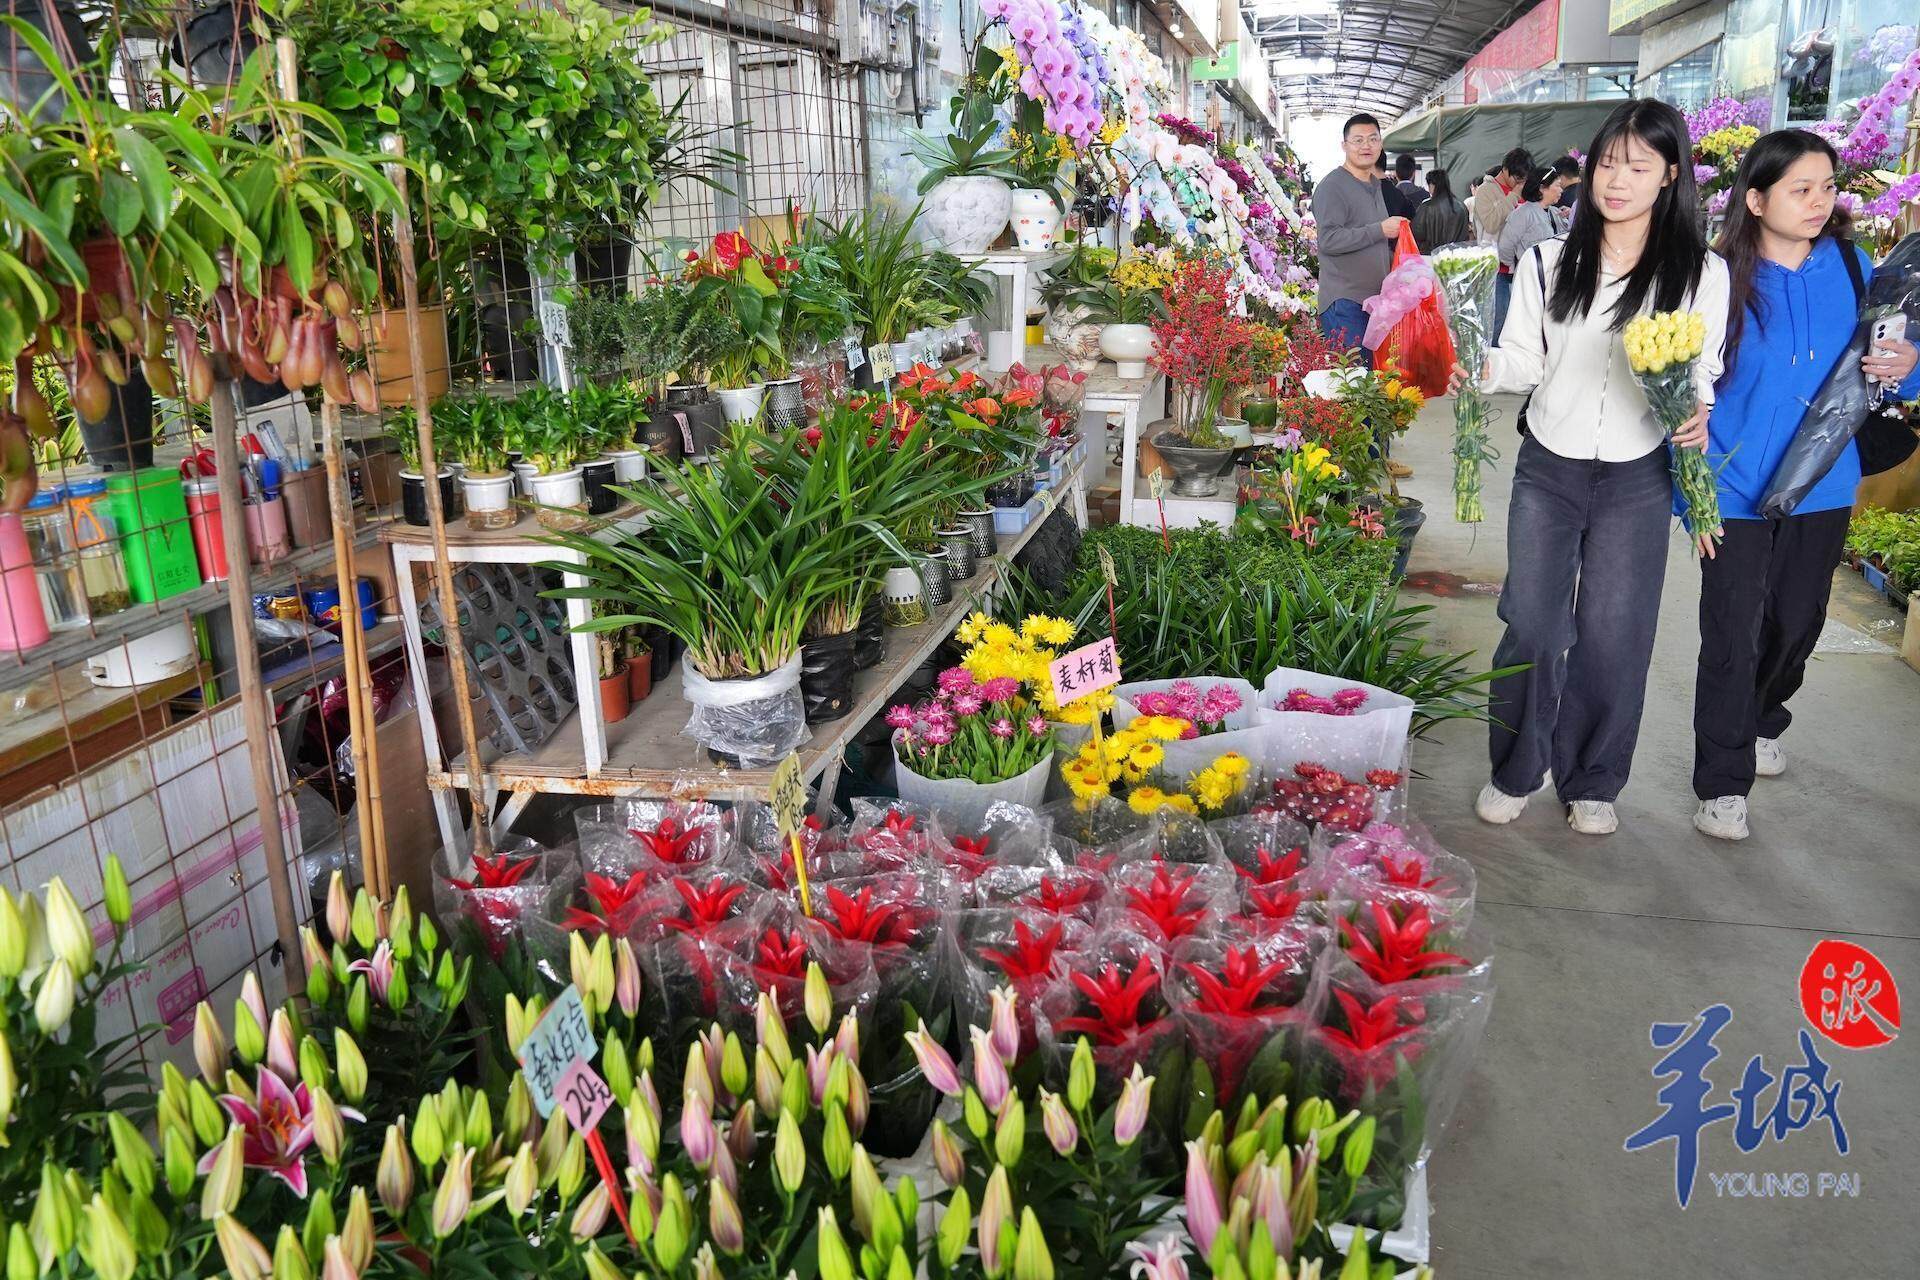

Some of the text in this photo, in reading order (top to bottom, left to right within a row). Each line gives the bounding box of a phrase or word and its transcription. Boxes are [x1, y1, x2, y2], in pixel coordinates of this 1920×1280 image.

[1059, 644, 1113, 693] 麦杆菊
[530, 1000, 588, 1101] 香水百合
[565, 1071, 612, 1127] 20元
